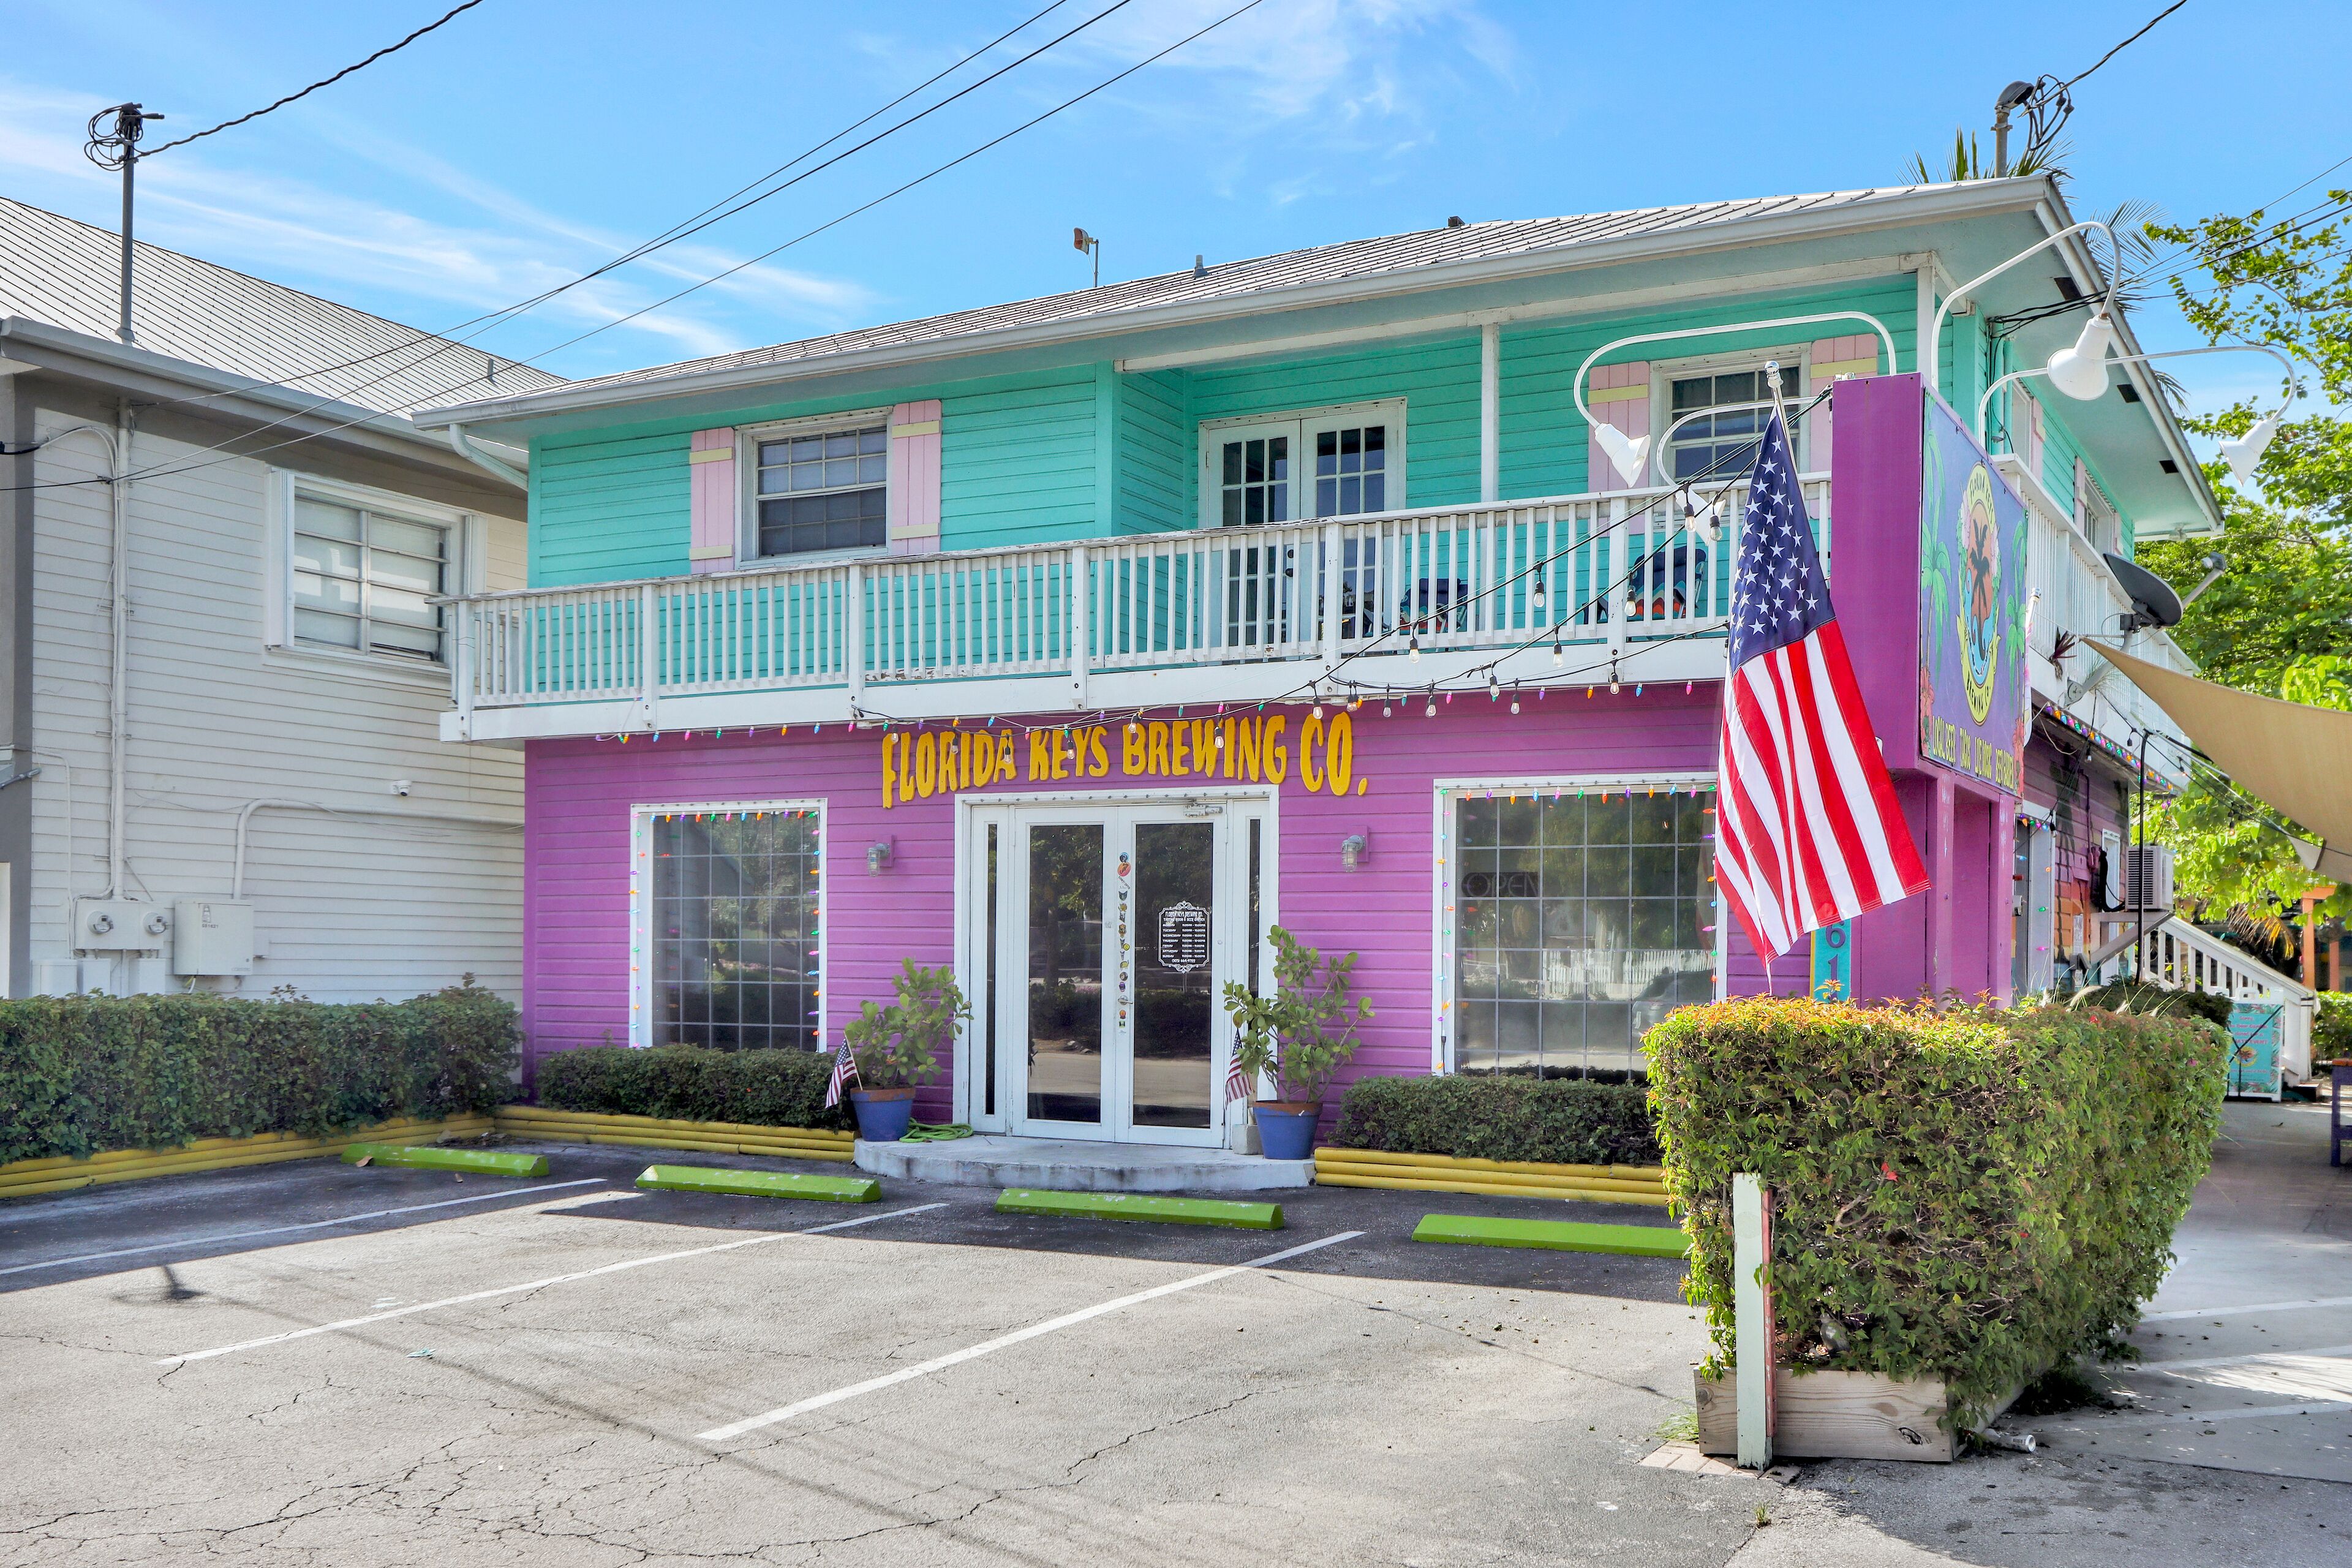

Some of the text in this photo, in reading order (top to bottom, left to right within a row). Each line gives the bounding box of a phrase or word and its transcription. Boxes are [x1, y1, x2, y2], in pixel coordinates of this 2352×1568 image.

[1970, 472, 1985, 505] FLORIDA
[1967, 671, 1984, 715] BREWING
[882, 711, 1368, 809] FLORIDA KEYS BREWING CO.
[1932, 715, 1946, 760] LOCAL
[1945, 723, 1956, 764] BEER
[1959, 727, 1971, 771] TACOS
[1466, 873, 1539, 897] OPEN
